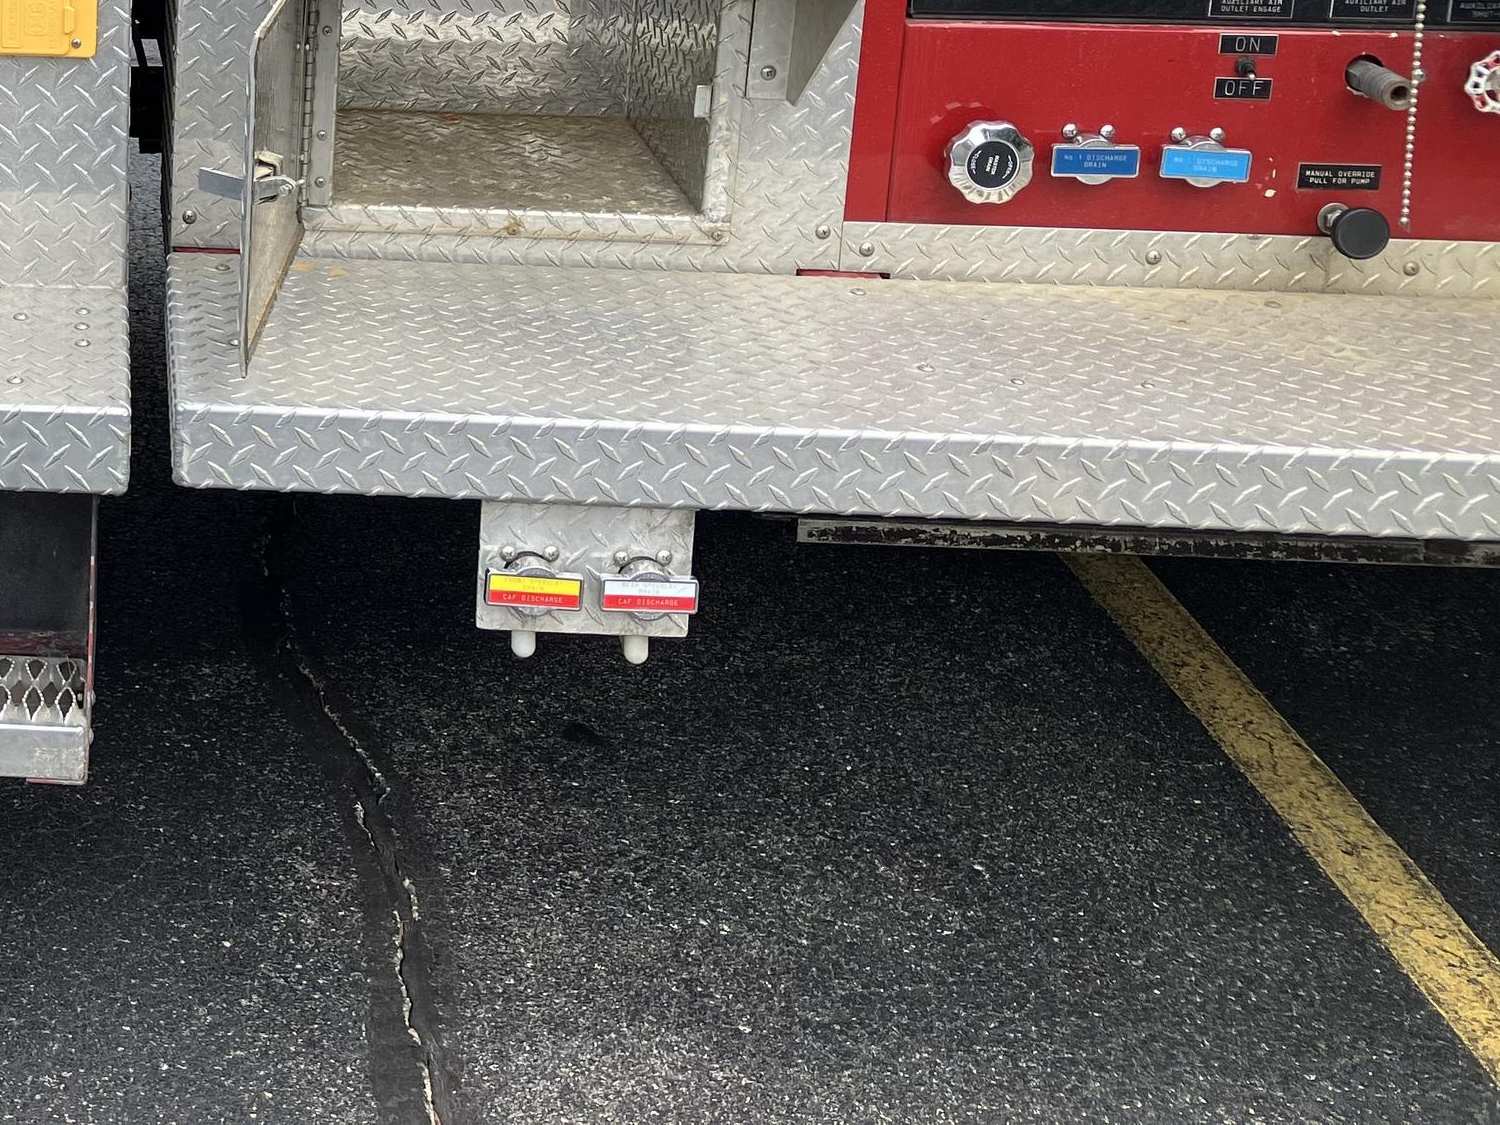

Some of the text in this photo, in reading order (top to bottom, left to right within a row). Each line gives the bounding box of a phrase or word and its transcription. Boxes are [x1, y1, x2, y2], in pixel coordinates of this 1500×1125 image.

[1235, 37, 1260, 52] ON
[1225, 80, 1264, 96] OFF
[1197, 158, 1239, 167] DISCHARGE
[522, 595, 563, 603] DISCHARGE
